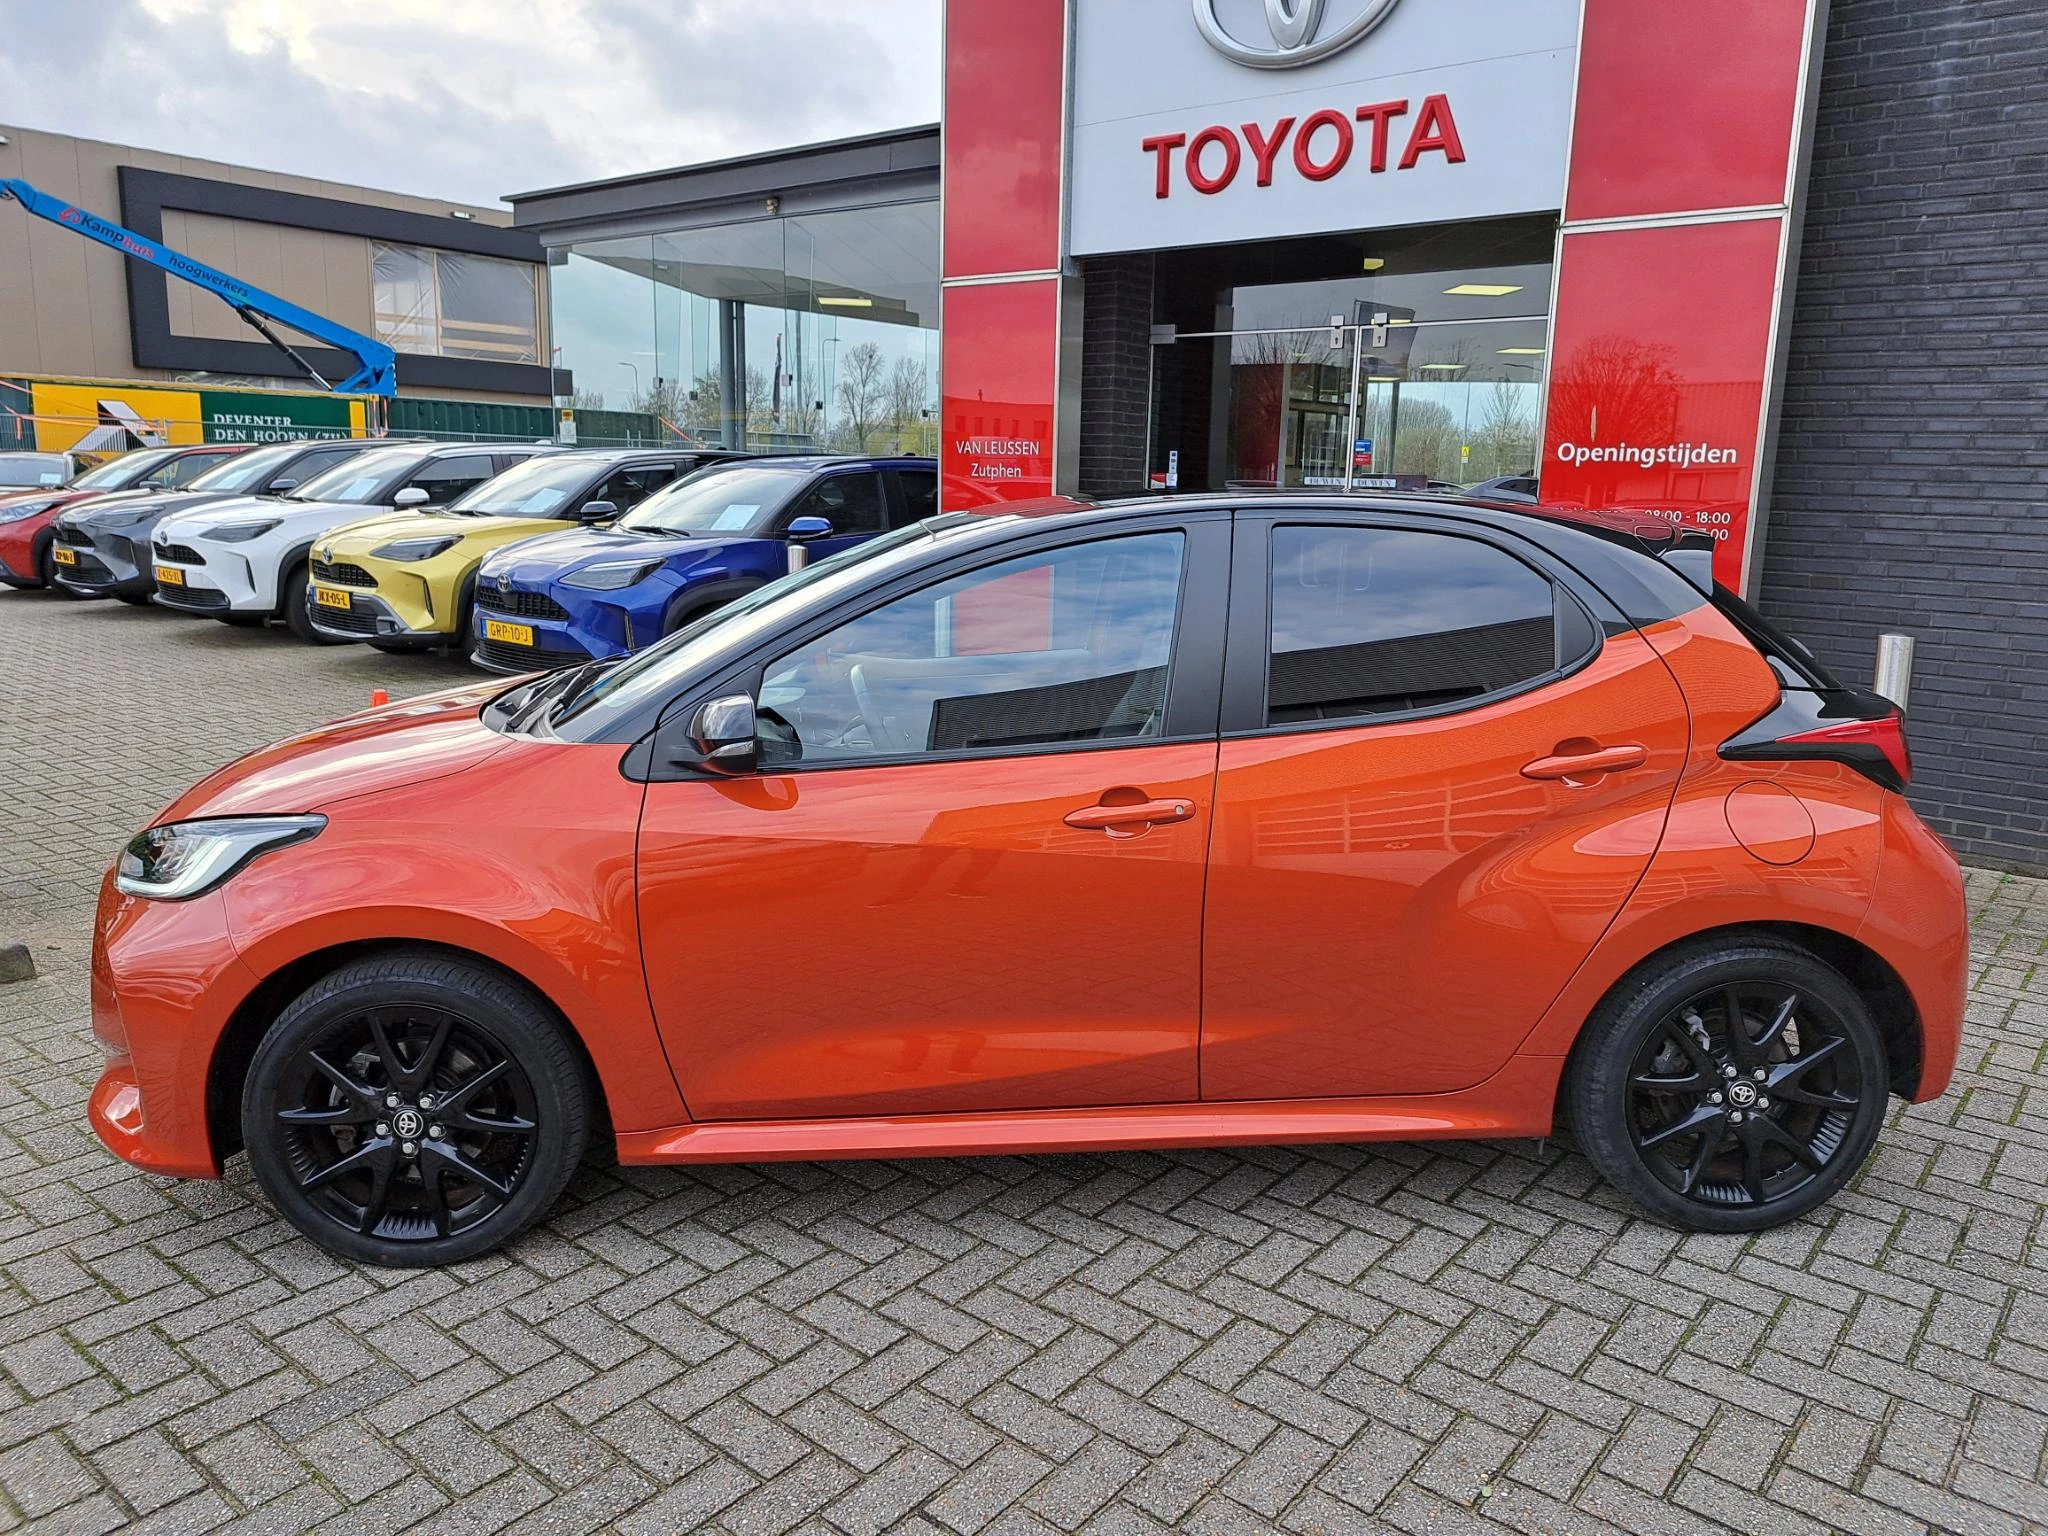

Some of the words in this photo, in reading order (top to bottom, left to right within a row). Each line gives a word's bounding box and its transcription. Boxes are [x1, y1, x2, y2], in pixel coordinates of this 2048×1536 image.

[1142, 93, 1466, 199] TOYOTA
[80, 214, 155, 259] Kamphuis
[169, 255, 249, 298] hoogwerkers
[213, 414, 292, 426] DEVENTER
[215, 429, 247, 441] DEN
[956, 441, 981, 454] VAN
[984, 441, 1040, 455] LEUSSEN
[1557, 442, 1737, 468] Openingstijden
[971, 463, 1022, 480] Zutphen
[1695, 511, 1731, 524] 18:00
[490, 623, 528, 642] GRP-10-J
